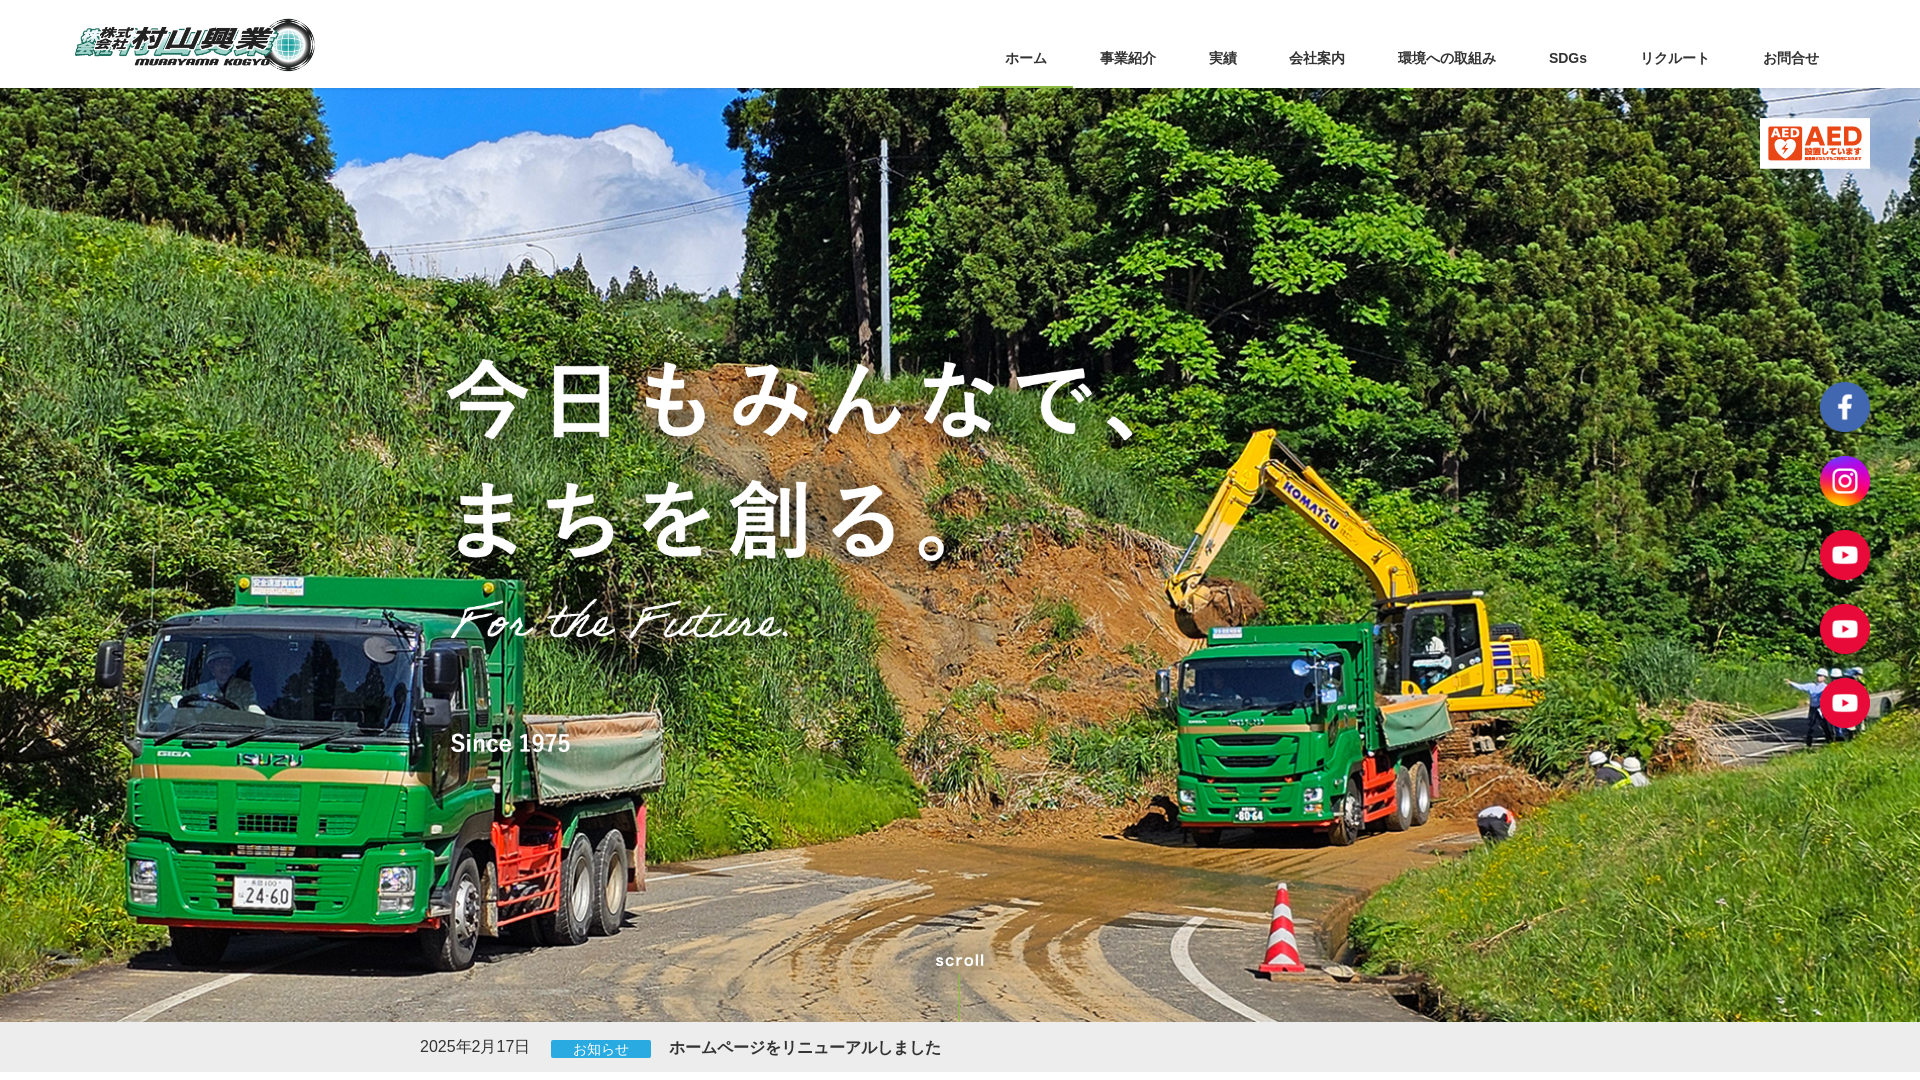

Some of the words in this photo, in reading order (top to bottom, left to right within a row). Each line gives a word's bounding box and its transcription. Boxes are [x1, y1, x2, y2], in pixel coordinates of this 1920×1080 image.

[1283, 481, 1340, 530] KOMATSU
[157, 750, 192, 758] GIGA
[236, 753, 303, 767] ISUZU
